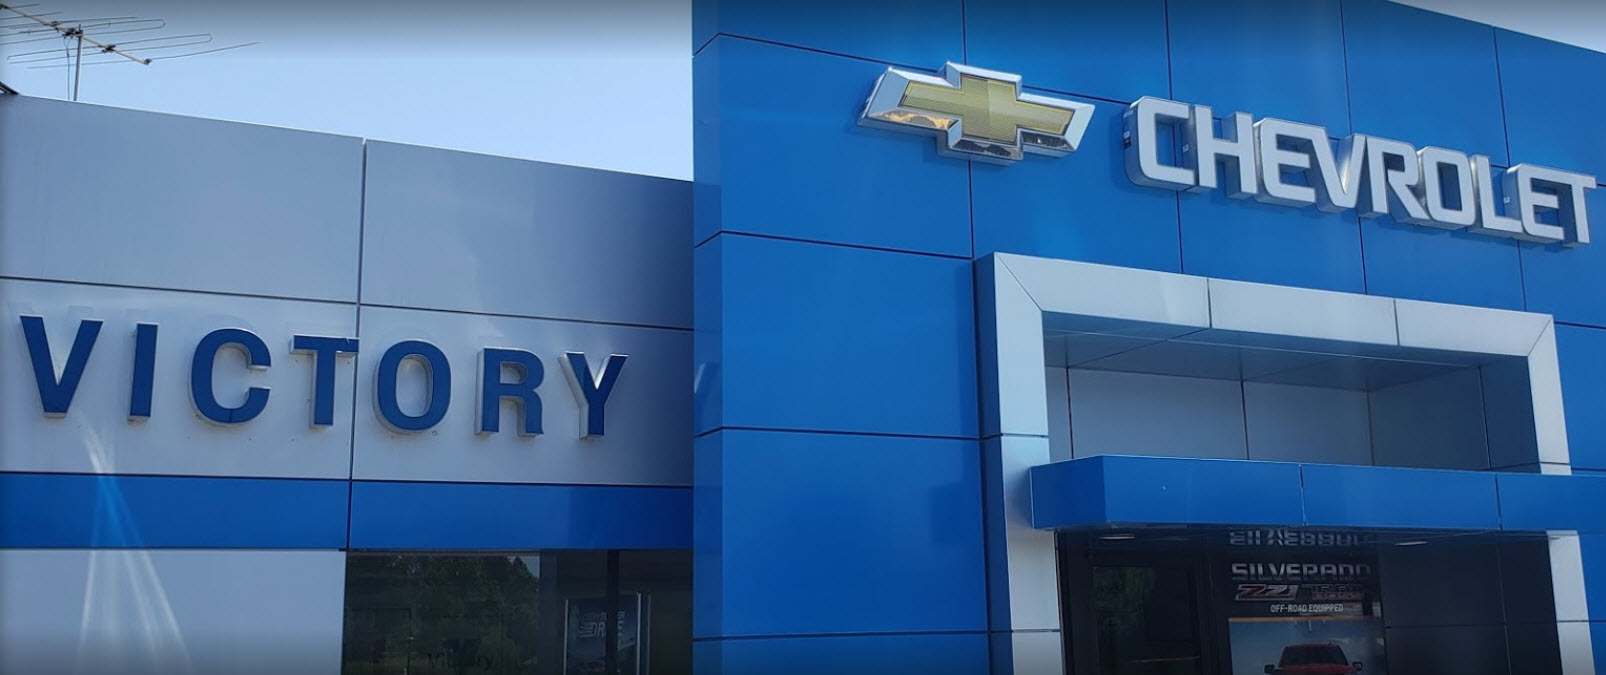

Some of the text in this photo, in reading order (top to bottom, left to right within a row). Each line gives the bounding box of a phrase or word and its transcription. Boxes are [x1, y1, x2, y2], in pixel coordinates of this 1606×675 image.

[1123, 96, 1597, 247] CHEVROLET
[20, 314, 628, 439] VICTORY
[1270, 603, 1344, 613] OFF-ROAD EQUIPPED
